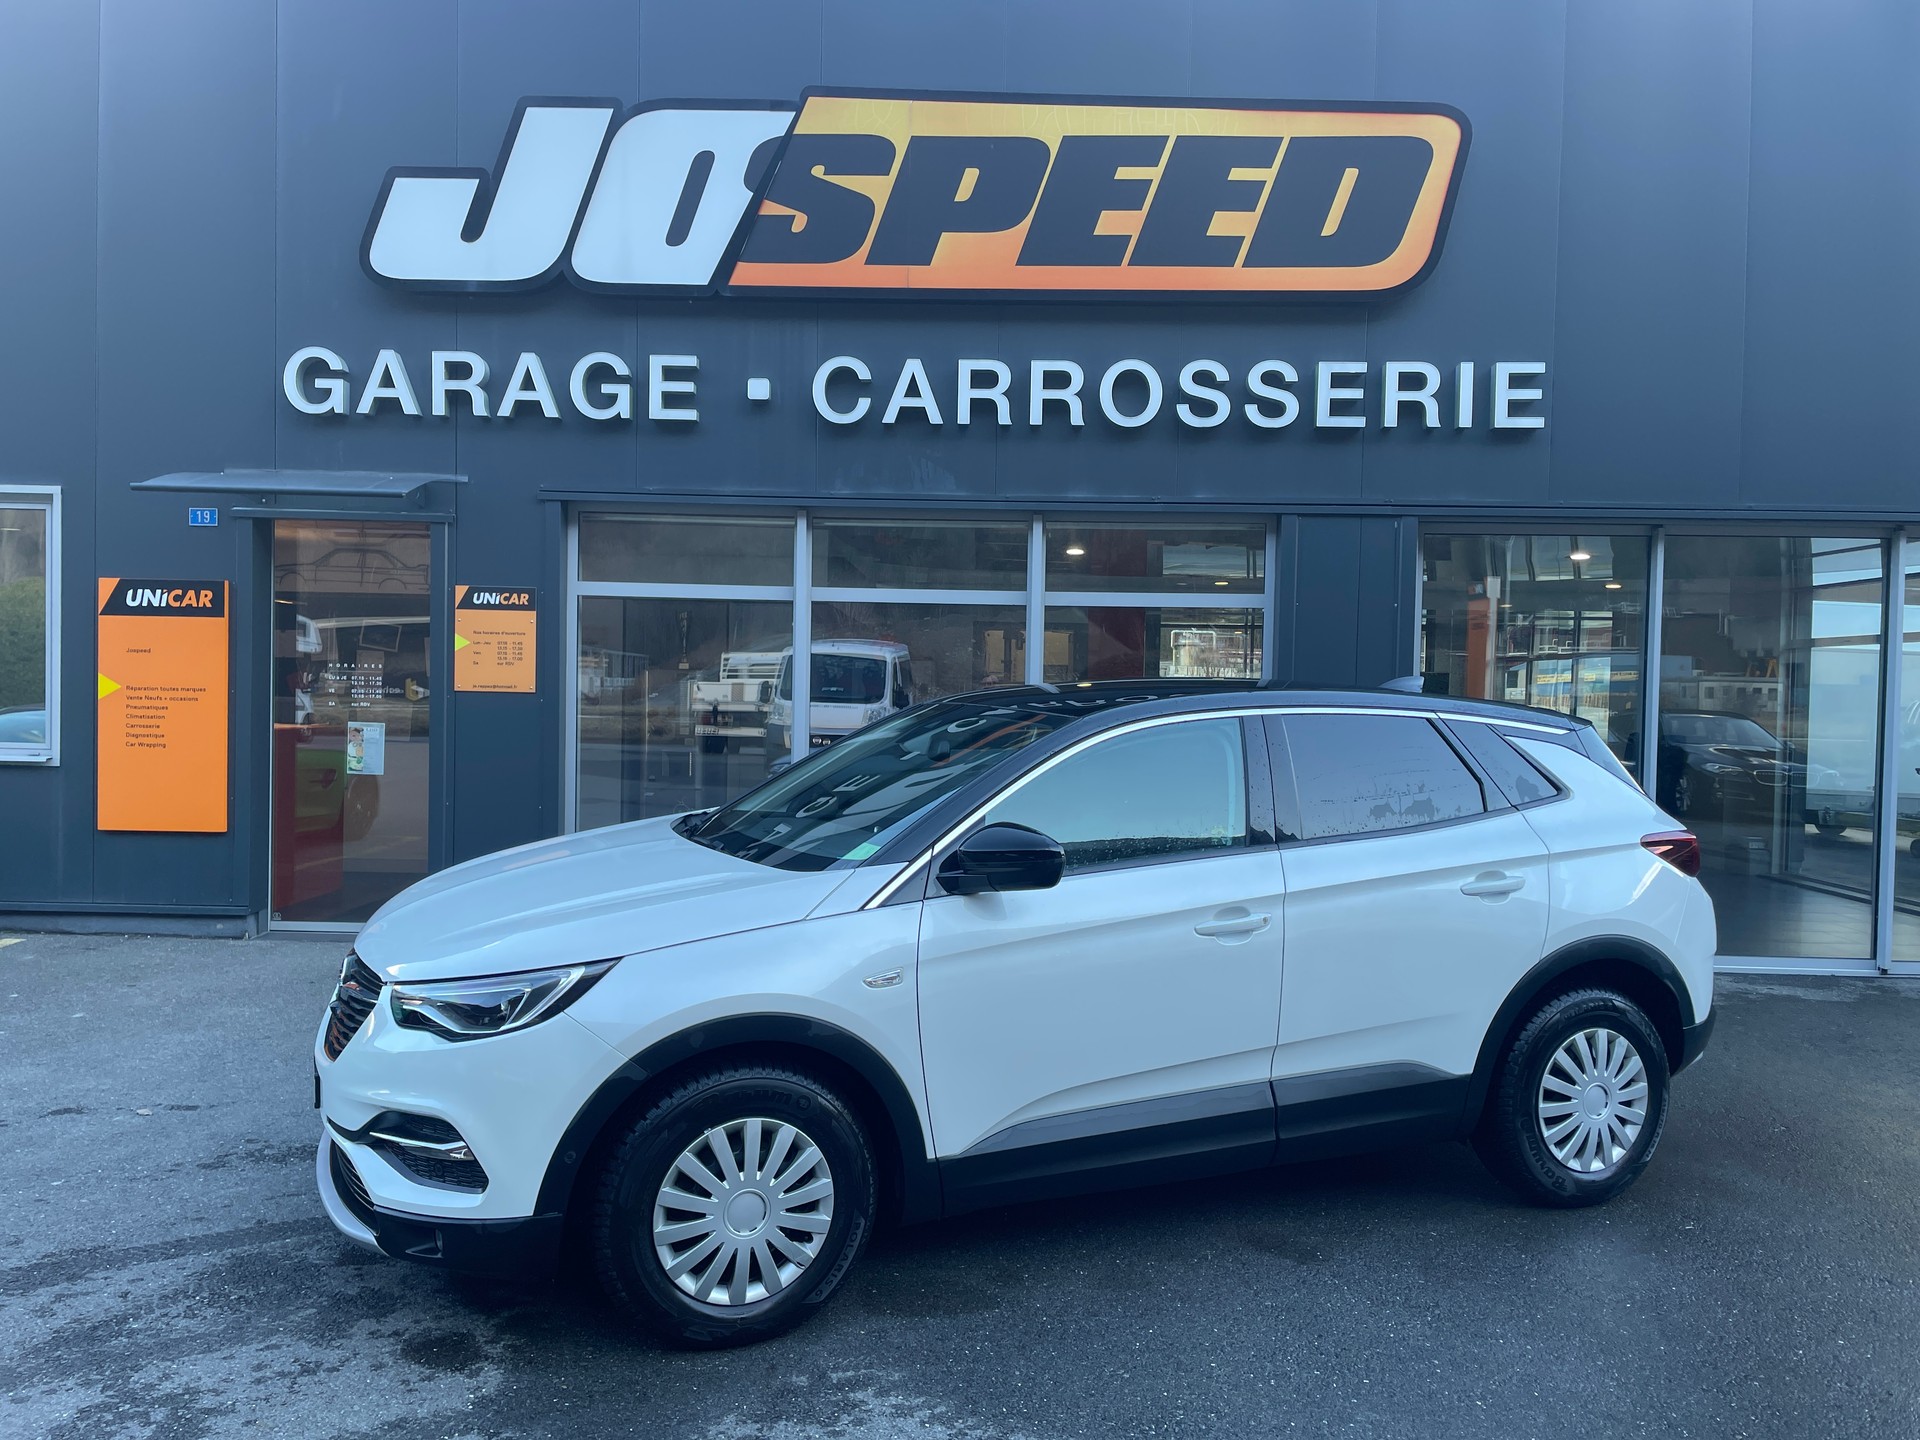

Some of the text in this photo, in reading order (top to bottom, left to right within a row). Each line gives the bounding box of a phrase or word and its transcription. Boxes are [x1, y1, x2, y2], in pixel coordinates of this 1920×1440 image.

[283, 346, 1547, 430] GARAGE CARROSSERIE
[196, 510, 210, 523] 19
[825, 1220, 862, 1287] POLARIS
